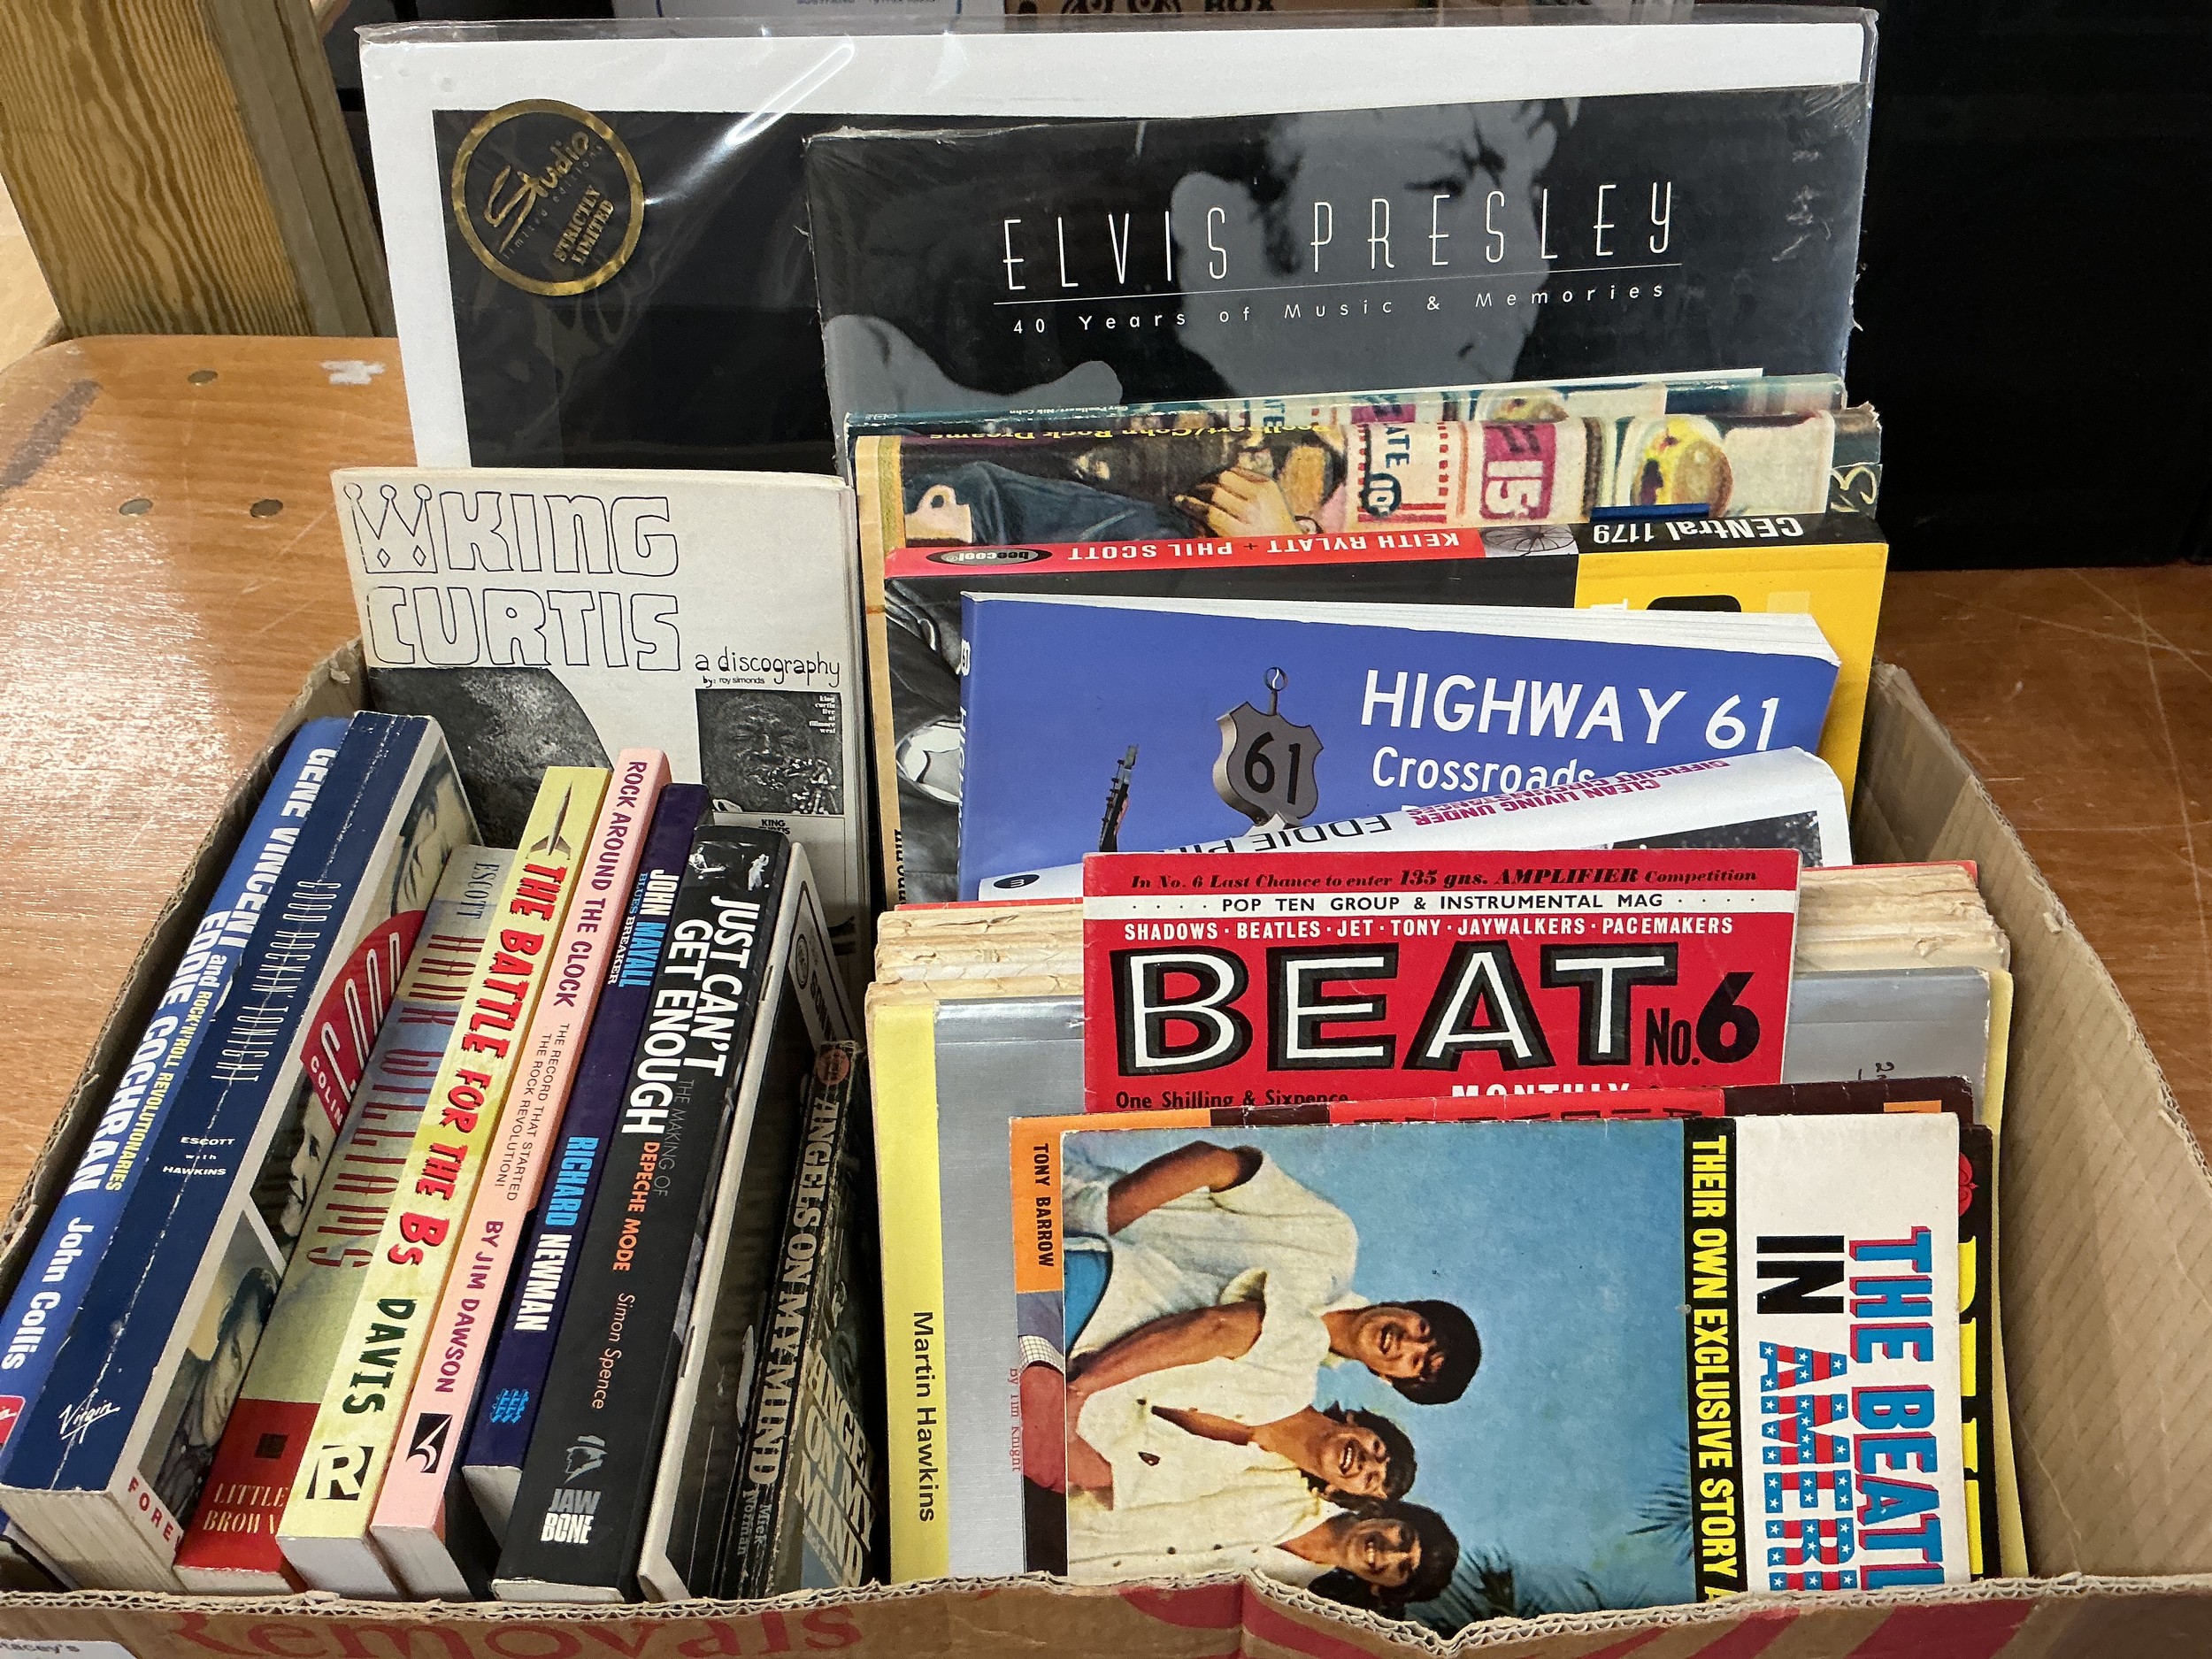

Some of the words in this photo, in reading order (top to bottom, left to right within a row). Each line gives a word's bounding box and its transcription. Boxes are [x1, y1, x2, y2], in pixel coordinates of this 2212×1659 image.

[485, 132, 589, 253] Studio
[553, 185, 601, 263] STRICTLY
[572, 200, 614, 265] LIMITED
[1002, 207, 1229, 291] ELVIS
[1310, 180, 1673, 274] PRESLEY
[1012, 318, 1047, 334] 40
[1078, 310, 1187, 332] Years
[1218, 304, 1251, 324] of
[1284, 298, 1394, 320] Music
[1425, 296, 1441, 311] &
[1475, 281, 1665, 310] Memories
[438, 489, 680, 577] KING
[1067, 544, 1156, 561] SCOTT
[1172, 541, 1233, 557] PHIL
[1266, 534, 1367, 553] RYLATT
[1376, 531, 1461, 551] KEITH
[1592, 523, 1655, 545] 1179
[366, 585, 680, 672] CURTIS
[694, 654, 710, 672] a
[718, 647, 841, 687] discography
[718, 676, 732, 685] roy
[732, 675, 765, 685] simonds
[1361, 669, 1687, 745] HIGHWAY
[1705, 694, 1779, 752] 61
[280, 748, 337, 818] GENE
[617, 760, 649, 809] ROCK
[1243, 731, 1302, 806] 61
[1373, 746, 1595, 794] Crossroads
[1593, 780, 1661, 803] CLEAN
[761, 818, 786, 827] KING
[1414, 798, 1496, 828] UNDER
[1500, 788, 1590, 815] LIVING
[591, 810, 632, 892] AROUND
[1252, 814, 1393, 851] EDDIE
[277, 879, 342, 923] GOOD
[457, 860, 502, 919] ESCOTT
[510, 862, 567, 922] THE
[627, 872, 648, 915] BLUES
[648, 869, 680, 916] JOHN
[1131, 875, 1151, 888] In
[1156, 875, 1187, 888] No.
[1191, 874, 1202, 888] 6
[1208, 874, 1235, 888] Last
[1243, 873, 1319, 889] Chance
[1324, 876, 1342, 888] to
[1346, 876, 1393, 888] enter
[1398, 869, 1438, 887] 135
[1444, 872, 1488, 890] gns.
[1495, 867, 1639, 886] AMPLIFIER
[1643, 868, 1757, 886] Competition
[1222, 897, 1268, 912] POP
[1276, 896, 1317, 912] TEN
[1330, 895, 1401, 911] GROUP
[1413, 895, 1426, 910] &
[1440, 894, 1604, 910] INSTRUMENTAL
[1617, 893, 1664, 908] MAG
[576, 896, 607, 933] THE
[703, 894, 761, 970] JUST
[1124, 921, 1218, 941] SHADOWS
[1236, 919, 1322, 940] BEATLES
[1336, 919, 1373, 939] JET
[1391, 918, 1441, 937] TONY
[1457, 917, 1586, 936] JAYWALKERS
[1601, 916, 1734, 936] PACEMAKERS
[164, 910, 225, 1004] EDDIE
[204, 954, 228, 988] and
[552, 940, 591, 1009] CLOCK
[608, 915, 635, 986] BREAKER
[618, 921, 667, 988] MAYALL
[664, 918, 714, 982] GET
[460, 926, 545, 1060] BATTLE
[1110, 940, 1678, 1078] BEAT
[1646, 1006, 1701, 1067] No.
[1694, 972, 1761, 1064] 6
[211, 1005, 289, 1083] TONIGHT
[536, 1035, 552, 1054] THE
[554, 1024, 571, 1045] THE
[681, 972, 743, 1078] CAN'T
[309, 1055, 343, 1125] COLIN
[523, 1061, 544, 1094] ROCK
[538, 1050, 562, 1100] RECORD
[620, 987, 696, 1135] ENOUGH
[67, 1015, 180, 1196] COCHRAN
[437, 1069, 495, 1135] FOR
[526, 1107, 546, 1136] THAT
[674, 1080, 694, 1103] THE
[1116, 1090, 1152, 1109] One
[1162, 1089, 1233, 1109] Shilling
[1243, 1087, 1256, 1105] &
[105, 1071, 175, 1193] REVOLUTIONARIES
[180, 1136, 235, 1147] ESCOTT
[495, 1102, 531, 1187] REVOLUTION!
[658, 1109, 686, 1169] MAKING
[162, 1165, 227, 1176] HAWKINS
[414, 1141, 470, 1202] THE
[506, 1143, 534, 1200] STARTED
[545, 1136, 600, 1226] RICHARD
[622, 1141, 660, 1213] DEPECHE
[653, 1177, 670, 1196] OF
[792, 1098, 840, 1228] ANGELS
[1033, 1142, 1050, 1187] TONY
[1692, 1134, 1727, 1217] THEIR
[42, 1216, 95, 1284] John
[387, 1210, 451, 1268] Bs
[477, 1220, 504, 1248] BY
[611, 1217, 642, 1272] MODE
[783, 1230, 821, 1286] ON
[1034, 1195, 1055, 1268] BARROW
[465, 1252, 495, 1289] JIM
[513, 1233, 572, 1332] NEWMAN
[1692, 1227, 1728, 1300] OWN
[1755, 1235, 1845, 1315] IN
[604, 1291, 636, 1341] Simon
[1848, 1225, 1934, 1365] THE
[1, 1291, 61, 1371] Collis
[342, 1297, 419, 1416] DAVIS
[434, 1298, 480, 1394] DAWSON
[772, 1293, 809, 1363] MY
[912, 1310, 935, 1399] Martin
[590, 1346, 623, 1410] Spence
[1692, 1308, 1732, 1469] EXCLUSIVE
[58, 1391, 120, 1444] Virgin
[749, 1362, 798, 1486] MIND
[915, 1405, 940, 1523] Hawkins
[213, 1483, 289, 1508] LITTLE
[549, 1487, 602, 1515] JAW
[539, 1514, 595, 1545] BONE
[1698, 1477, 1736, 1578] STORY
